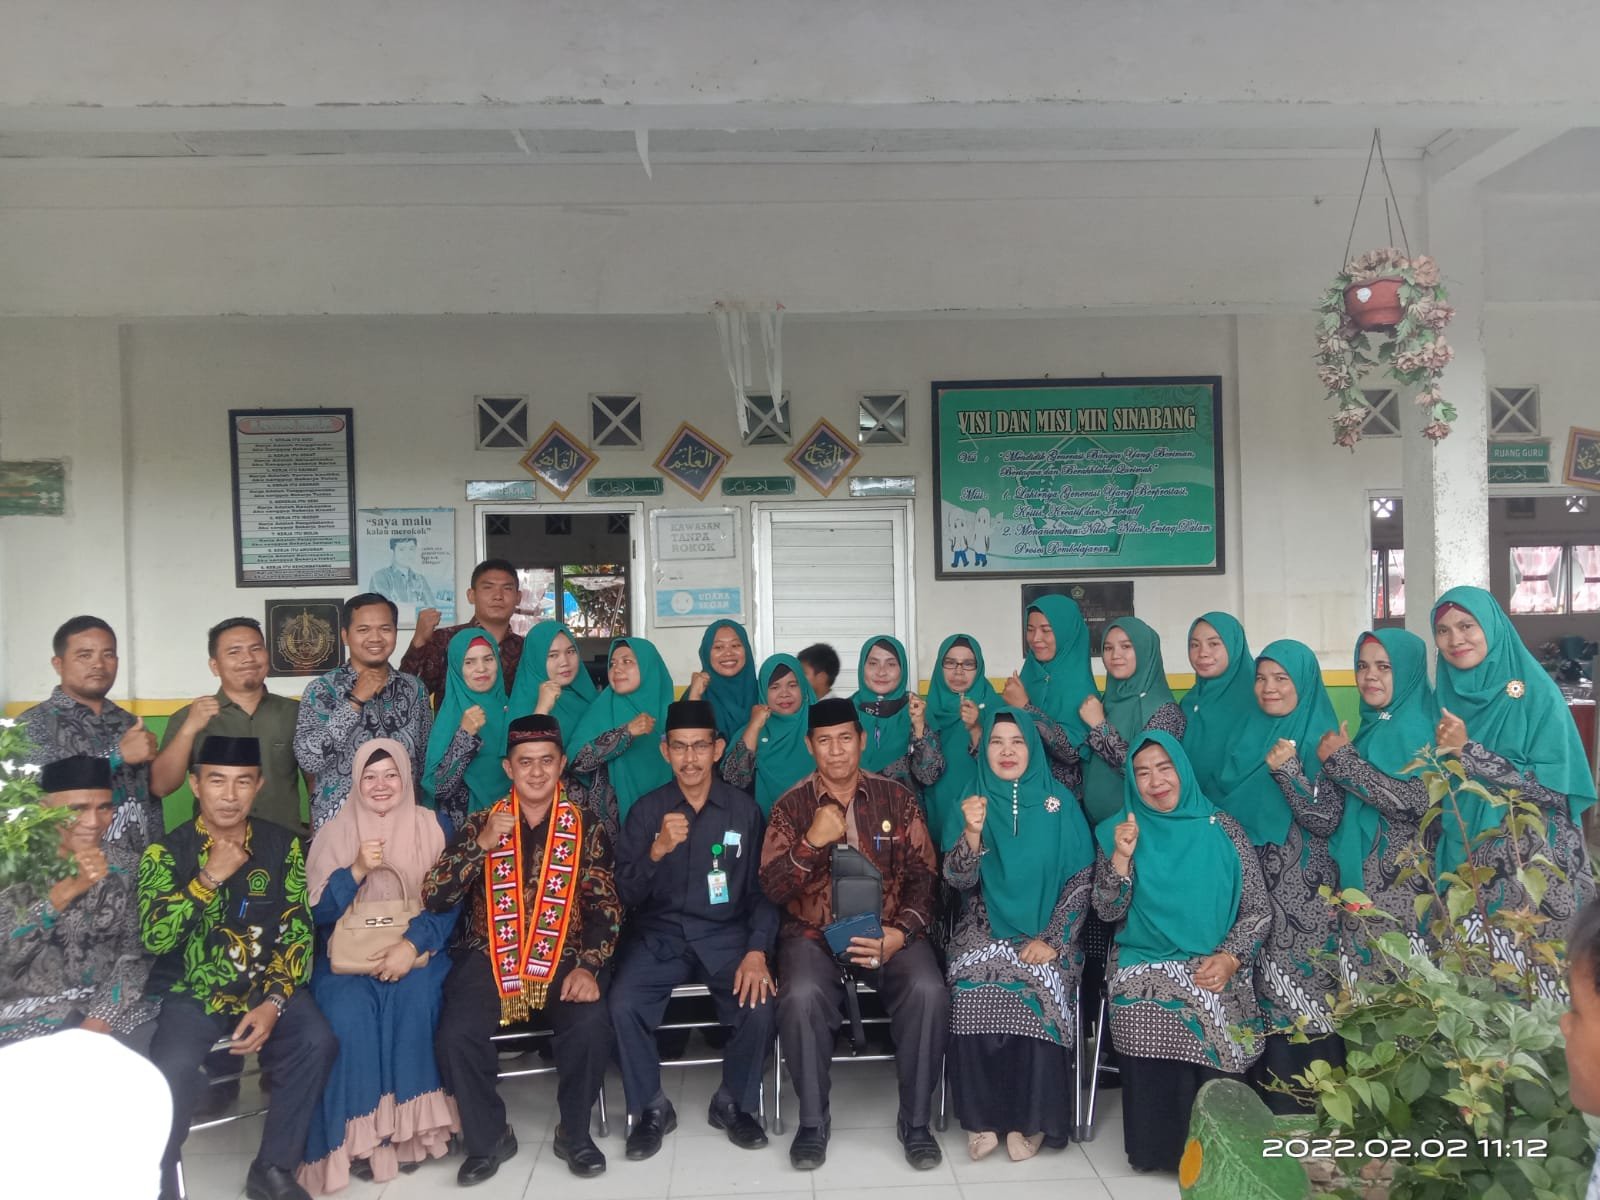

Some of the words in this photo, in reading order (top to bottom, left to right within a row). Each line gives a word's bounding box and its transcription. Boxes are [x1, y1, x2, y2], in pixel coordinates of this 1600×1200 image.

[957, 411, 993, 435] VISI
[995, 409, 1031, 433] DAN
[1036, 408, 1073, 432] MISI
[1075, 407, 1108, 431] MIN
[1112, 405, 1196, 431] SINABANG
[1123, 447, 1152, 463] Yang
[1494, 448, 1521, 457] RUANG
[1522, 447, 1544, 457] GURU
[1103, 482, 1133, 502] Yang
[1083, 505, 1102, 517] dan
[402, 515, 432, 527] malu
[671, 522, 721, 532] KAWASAN
[671, 532, 711, 542] TANPA
[1001, 525, 1012, 537] 2.
[671, 543, 717, 553] ROKOK
[1014, 541, 1044, 555] Proses
